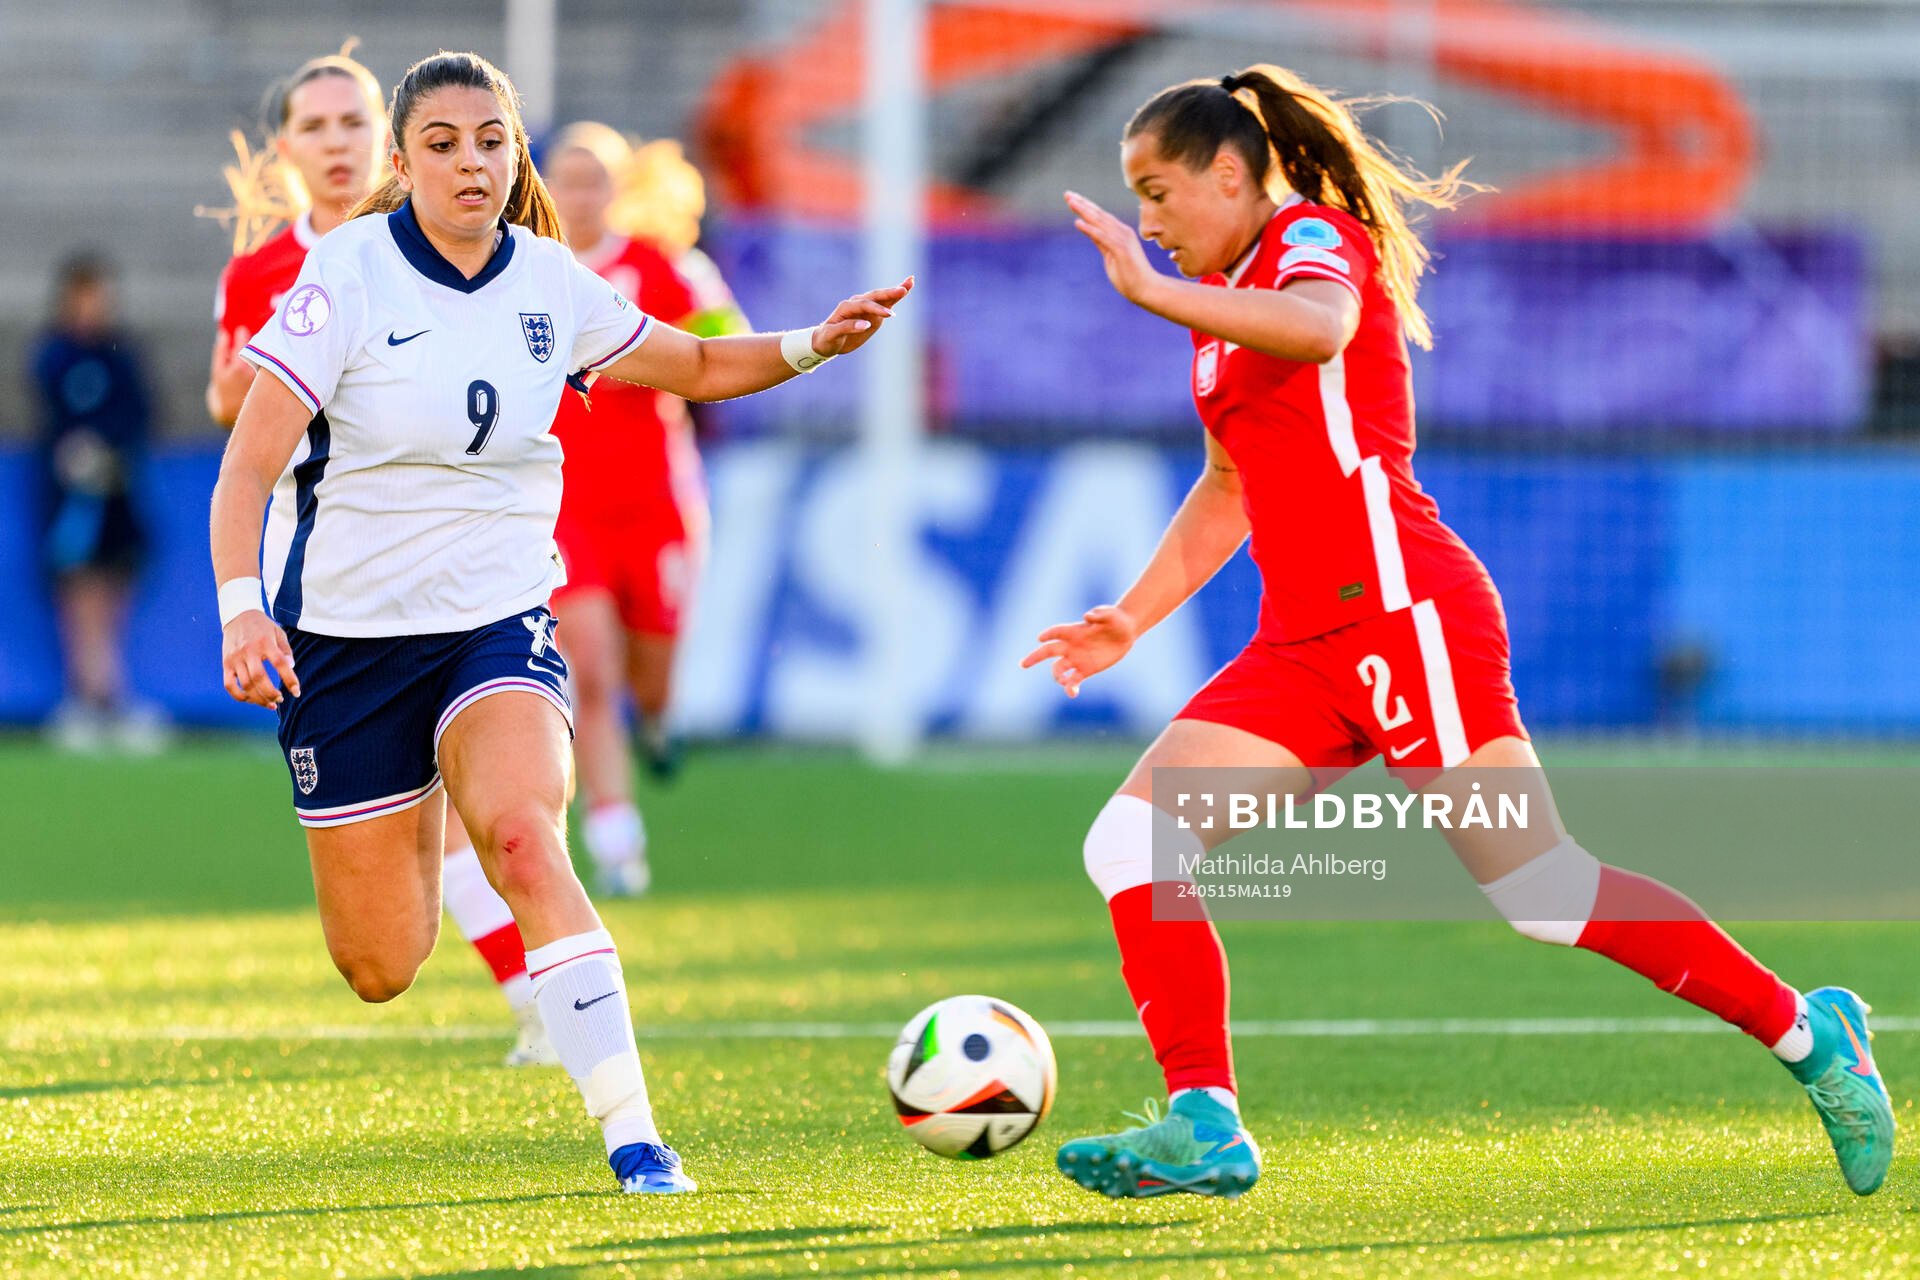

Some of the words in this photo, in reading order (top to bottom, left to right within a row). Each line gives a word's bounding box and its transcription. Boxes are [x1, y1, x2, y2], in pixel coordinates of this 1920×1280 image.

[465, 379, 500, 455] 9
[664, 442, 1215, 738] ISA
[1356, 654, 1413, 731] 2
